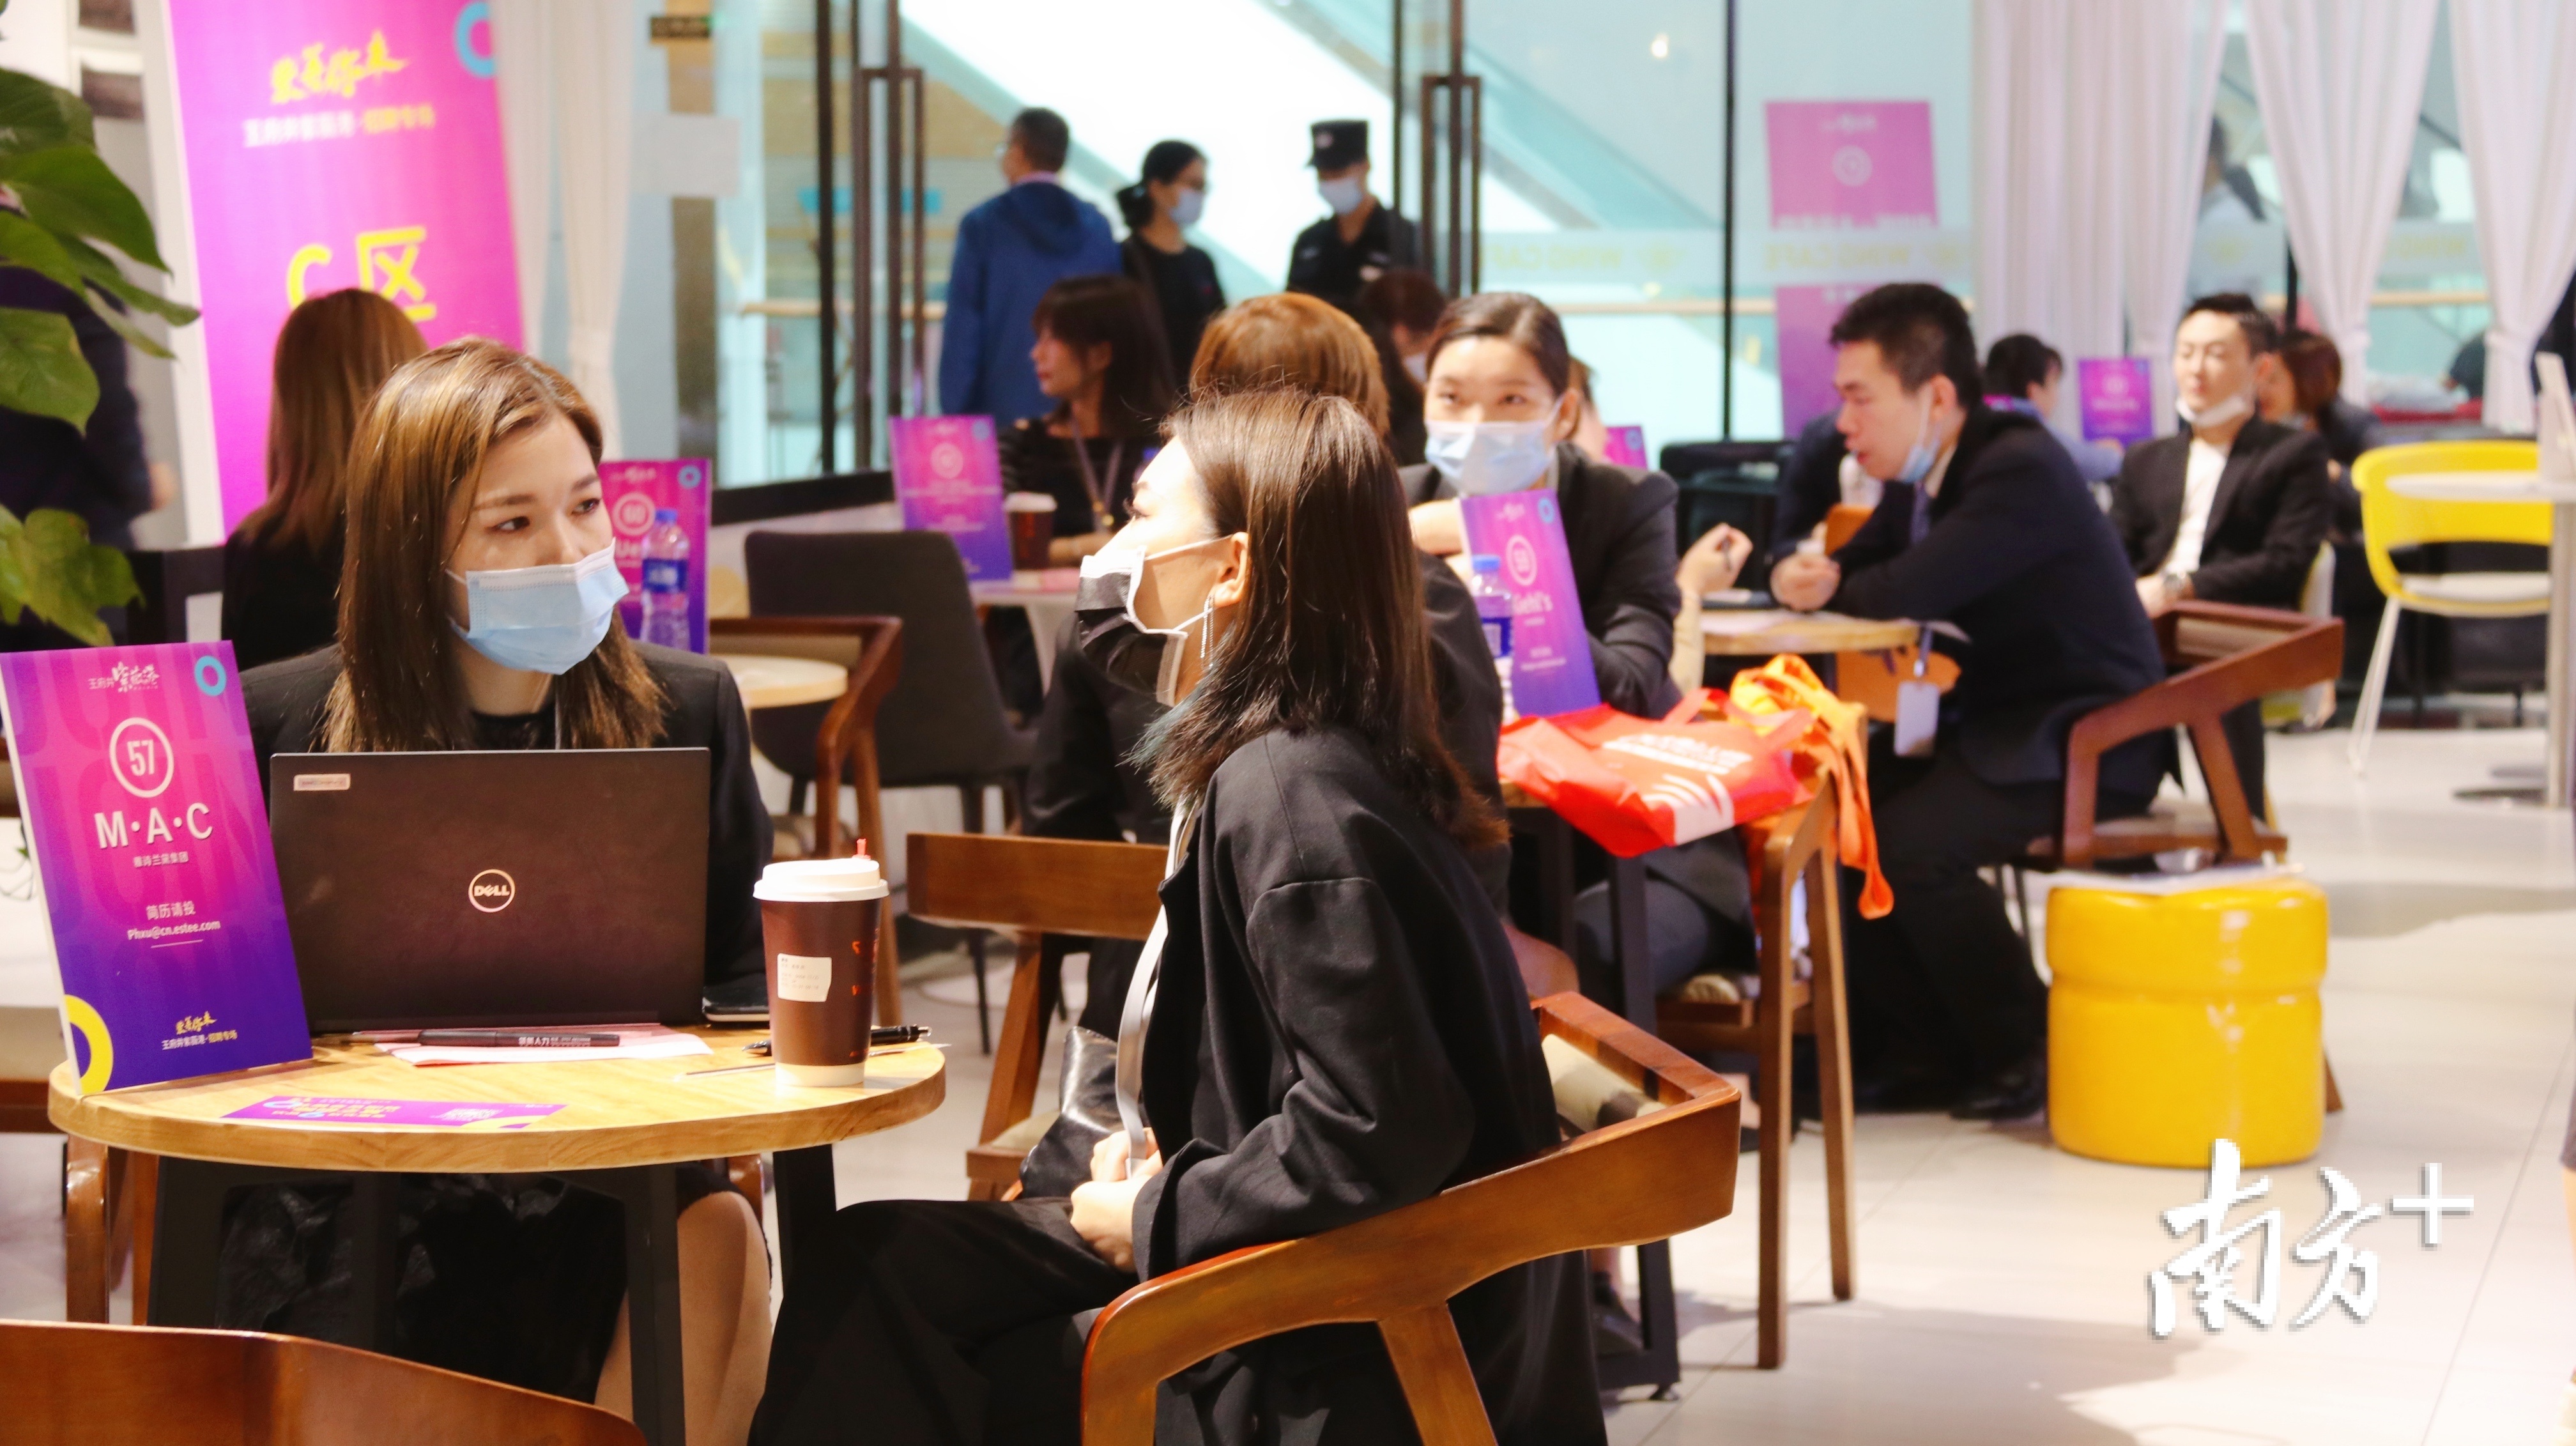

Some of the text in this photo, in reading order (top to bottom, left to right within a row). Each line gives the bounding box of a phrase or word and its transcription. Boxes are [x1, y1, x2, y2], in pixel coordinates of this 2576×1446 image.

[127, 739, 155, 776] 57
[473, 884, 510, 897] DELL
[146, 900, 196, 921] 简历请投
